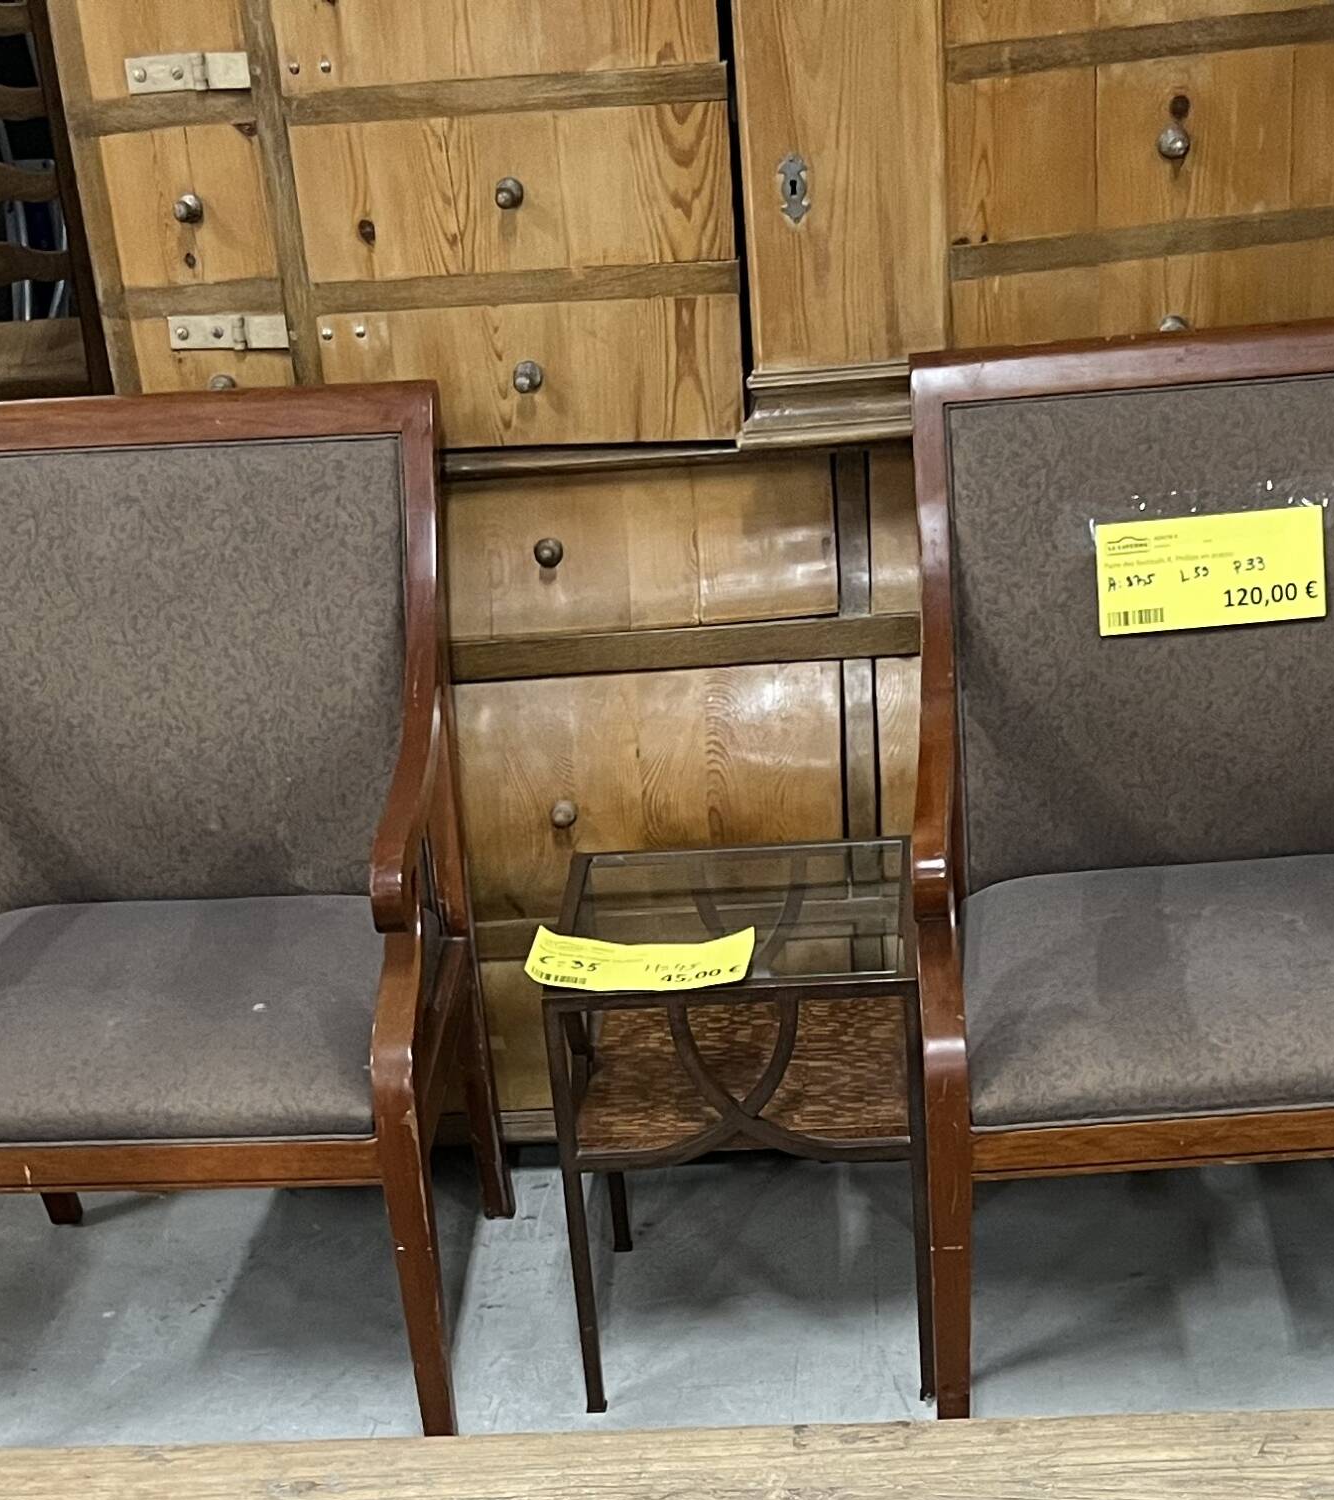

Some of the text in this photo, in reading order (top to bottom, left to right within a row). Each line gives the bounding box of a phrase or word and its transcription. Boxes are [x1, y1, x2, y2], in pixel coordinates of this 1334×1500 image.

[1223, 580, 1319, 607] 120,00 €
[660, 968, 722, 983] 45,00
